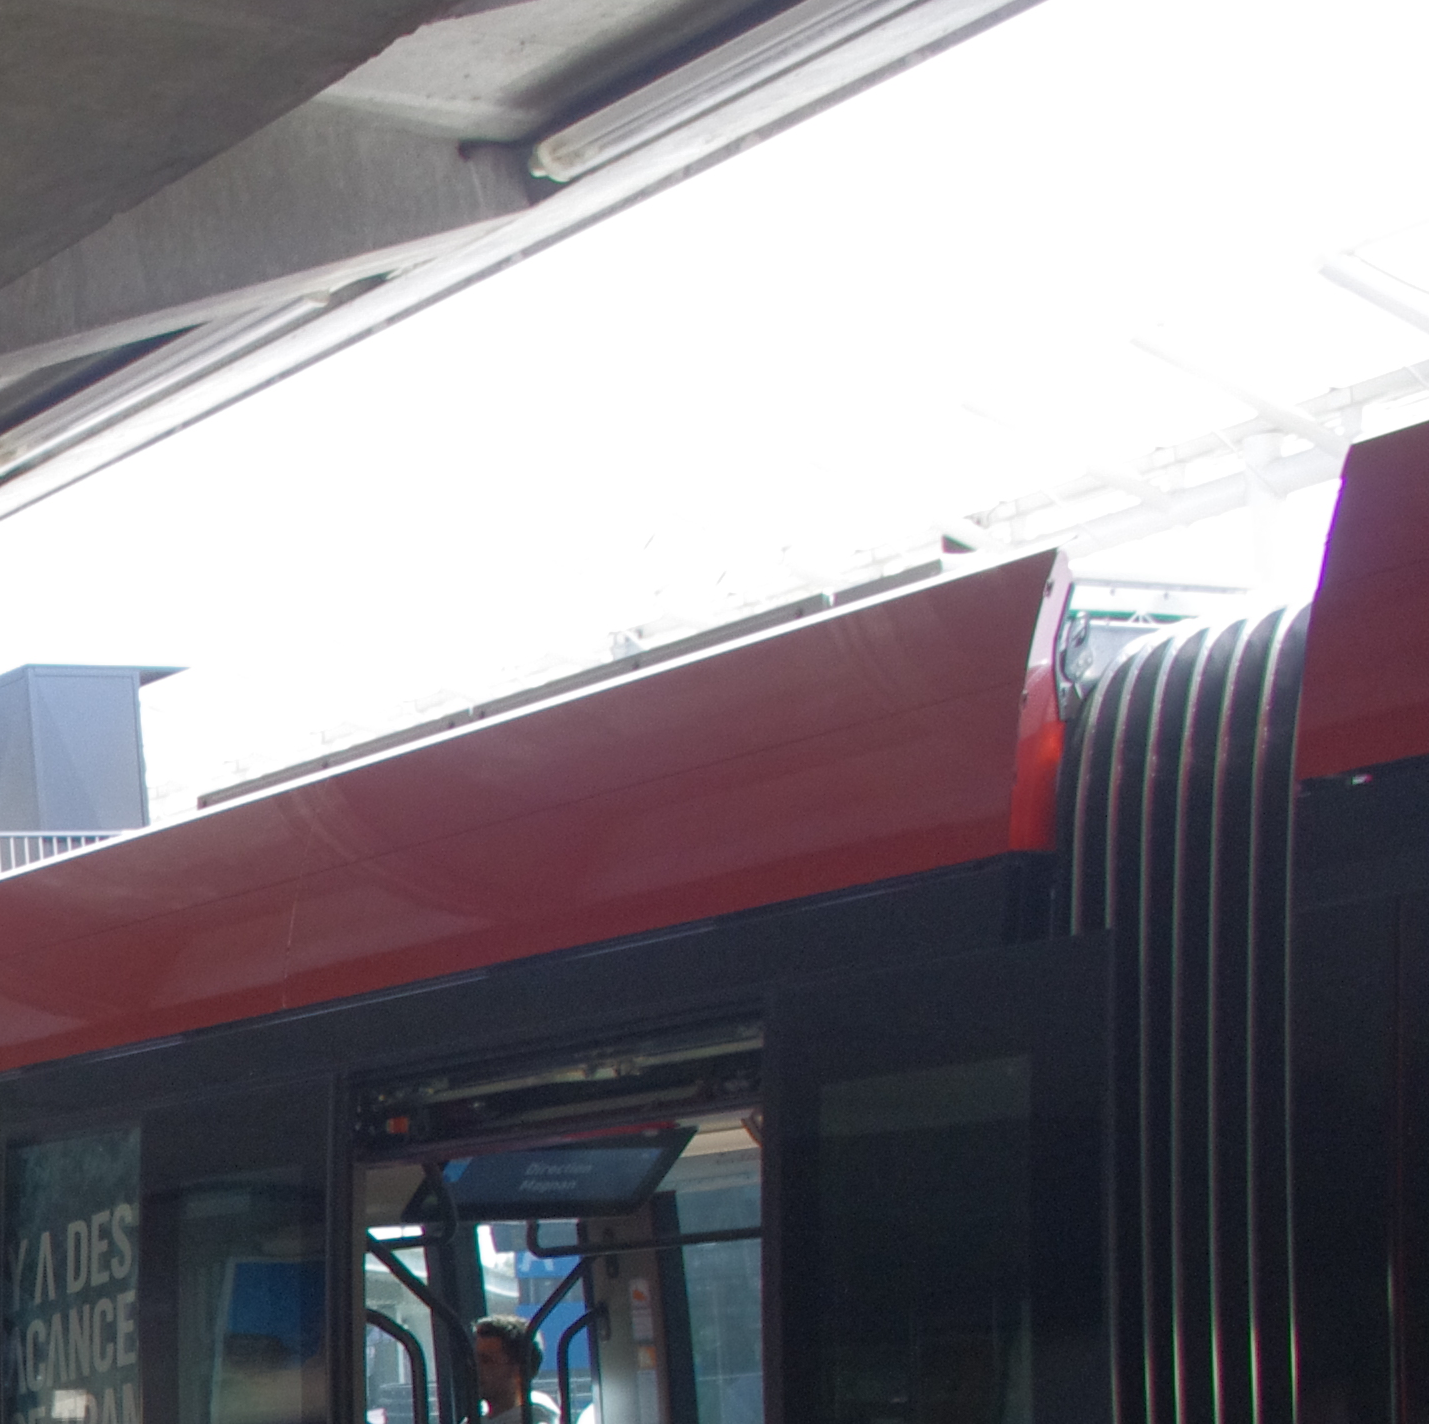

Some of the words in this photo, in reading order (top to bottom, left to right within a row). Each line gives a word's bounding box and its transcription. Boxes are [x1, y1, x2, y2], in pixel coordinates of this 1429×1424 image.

[526, 1161, 592, 1176] Direction
[518, 1179, 577, 1193] Magnan
[66, 1203, 134, 1294] DES
